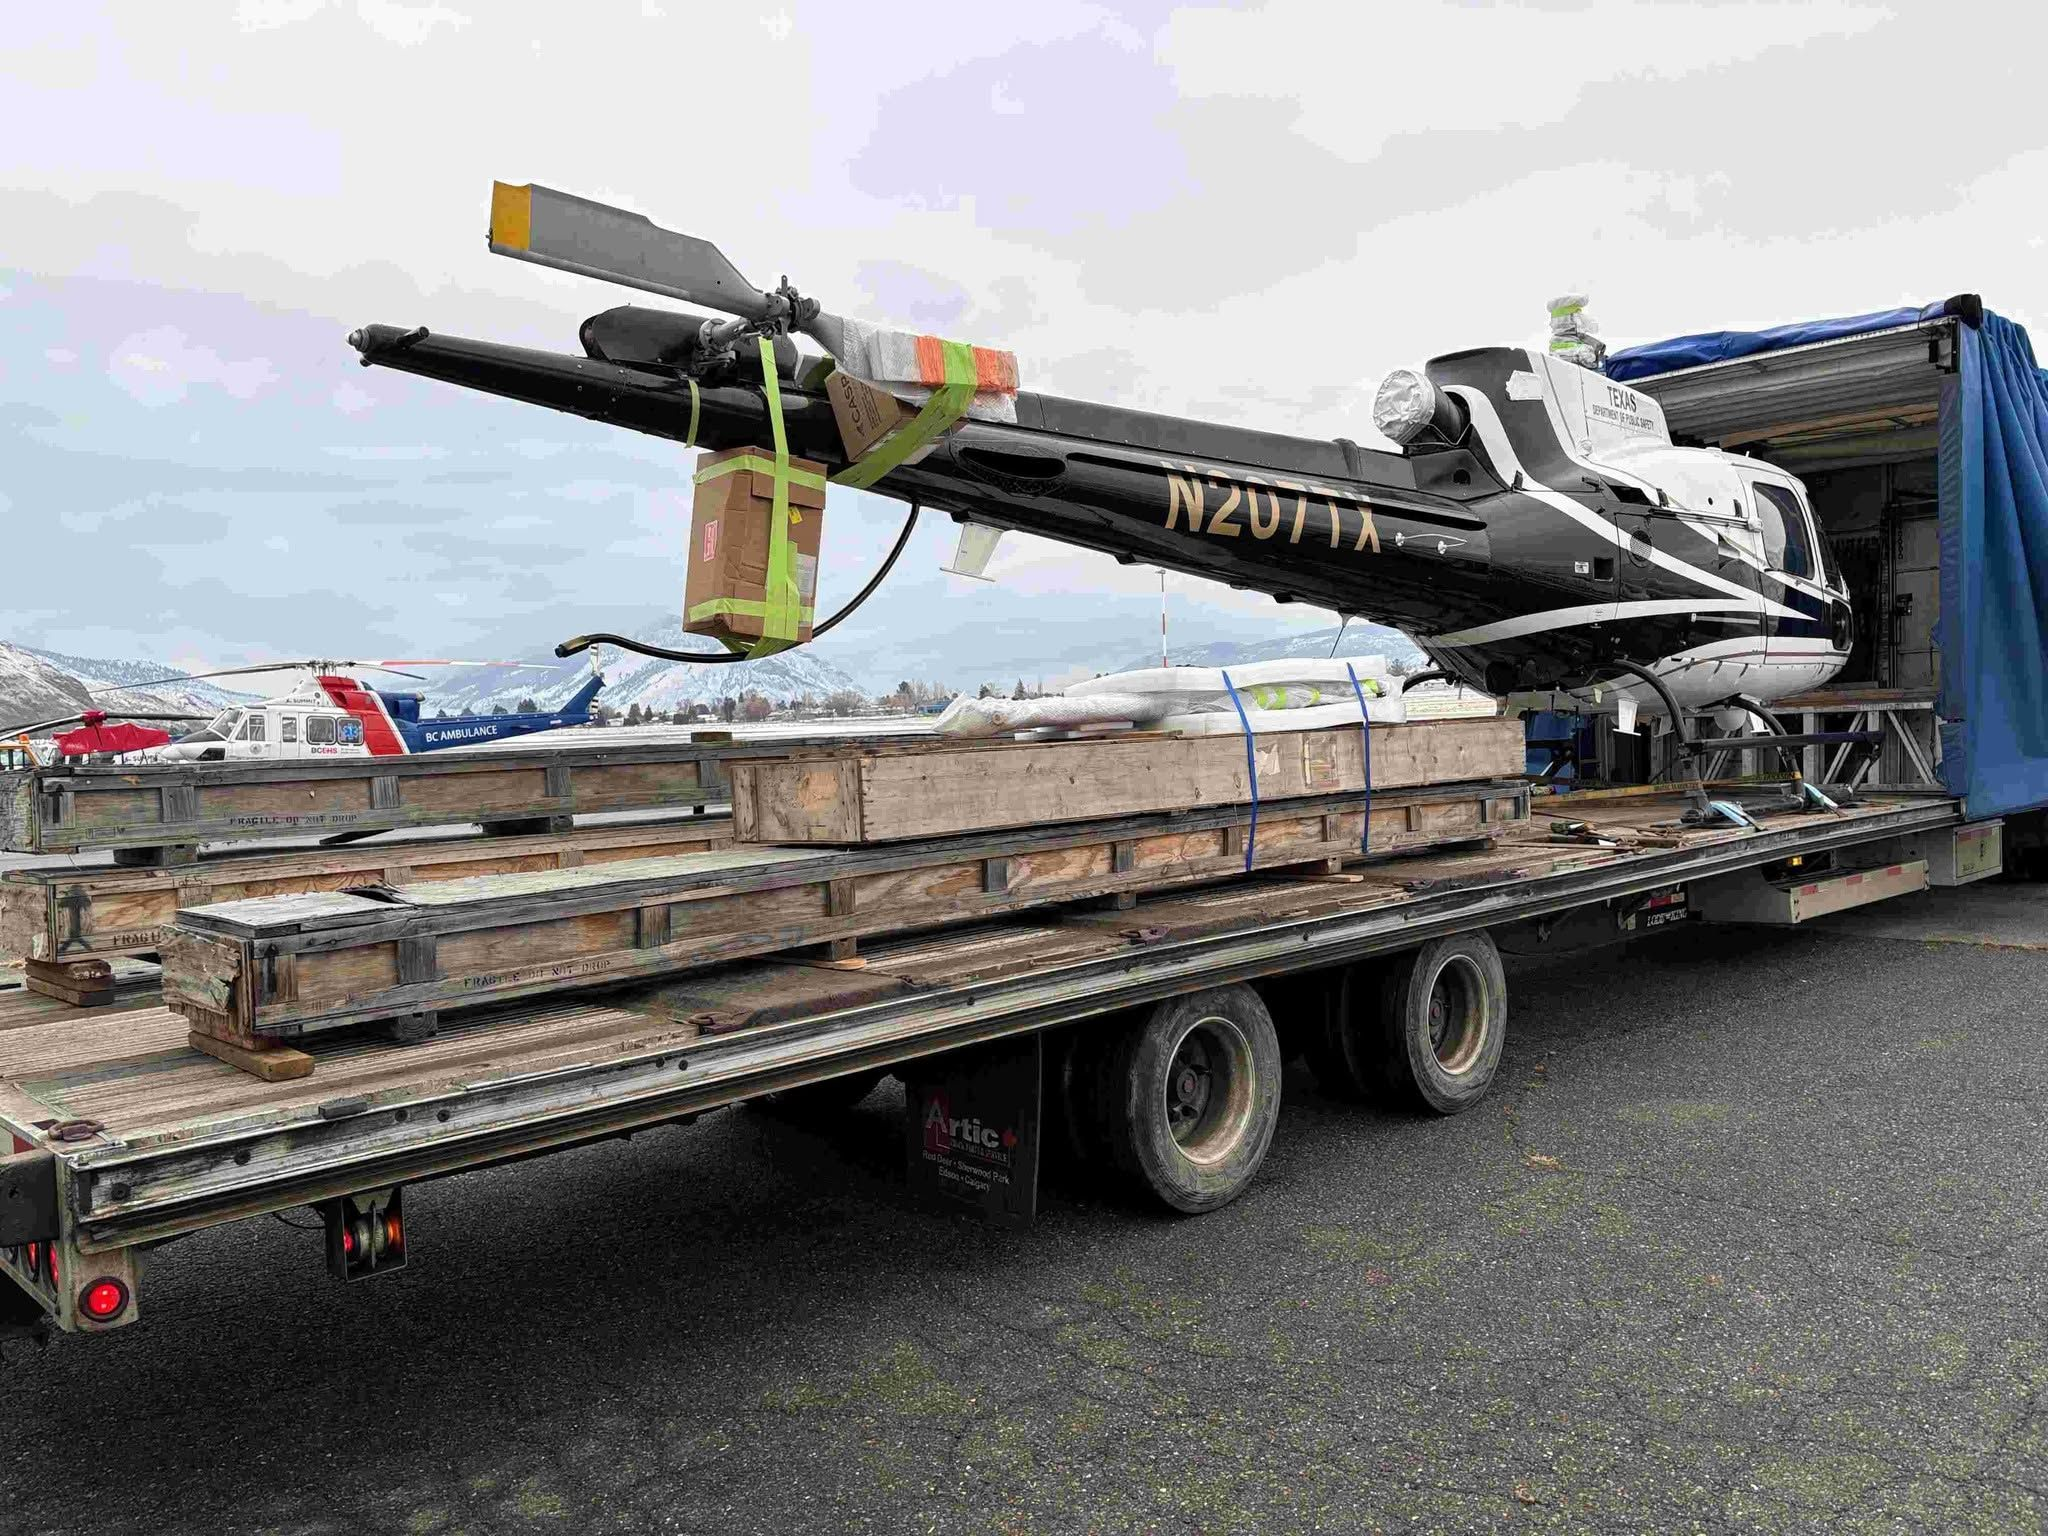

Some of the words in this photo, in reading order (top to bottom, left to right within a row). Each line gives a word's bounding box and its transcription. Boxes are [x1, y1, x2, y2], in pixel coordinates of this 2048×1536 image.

[1606, 385, 1637, 413] TEXAS
[1592, 404, 1619, 421] DEPARTMENT
[1625, 412, 1640, 427] PUBLIC
[1640, 416, 1654, 431] SAFETY
[425, 731, 439, 742] BC
[440, 725, 498, 741] AMBULANCE
[230, 816, 280, 826] FRAGILE
[925, 1097, 1000, 1149] Artic
[992, 1171, 1010, 1185] Park
